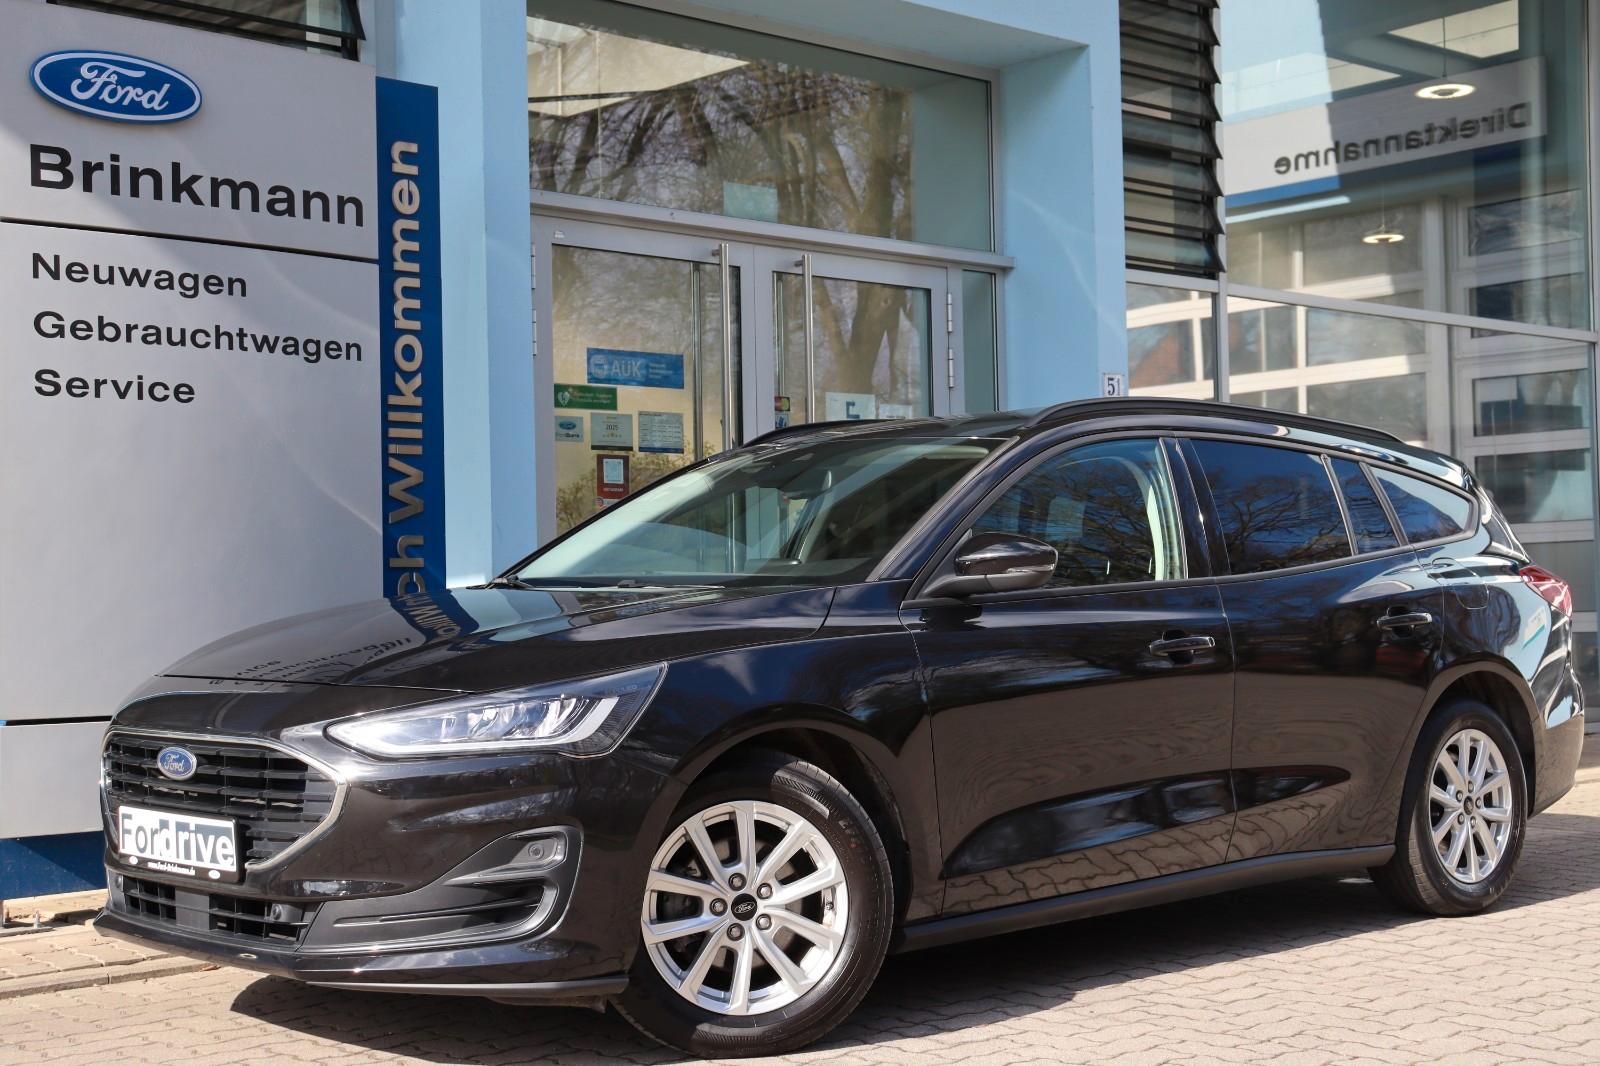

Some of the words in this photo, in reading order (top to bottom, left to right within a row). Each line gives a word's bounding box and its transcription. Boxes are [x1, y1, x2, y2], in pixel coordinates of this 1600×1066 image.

[69, 61, 170, 112] Ford
[29, 143, 365, 228] Brinkmann
[31, 252, 248, 298] Neuwagen
[33, 311, 363, 364] Gebrauchtwagen
[387, 139, 425, 525] Willkommen
[33, 368, 196, 404] Service
[1107, 377, 1120, 396] 51
[164, 753, 185, 772] Ford
[121, 812, 235, 866] Fordrive
